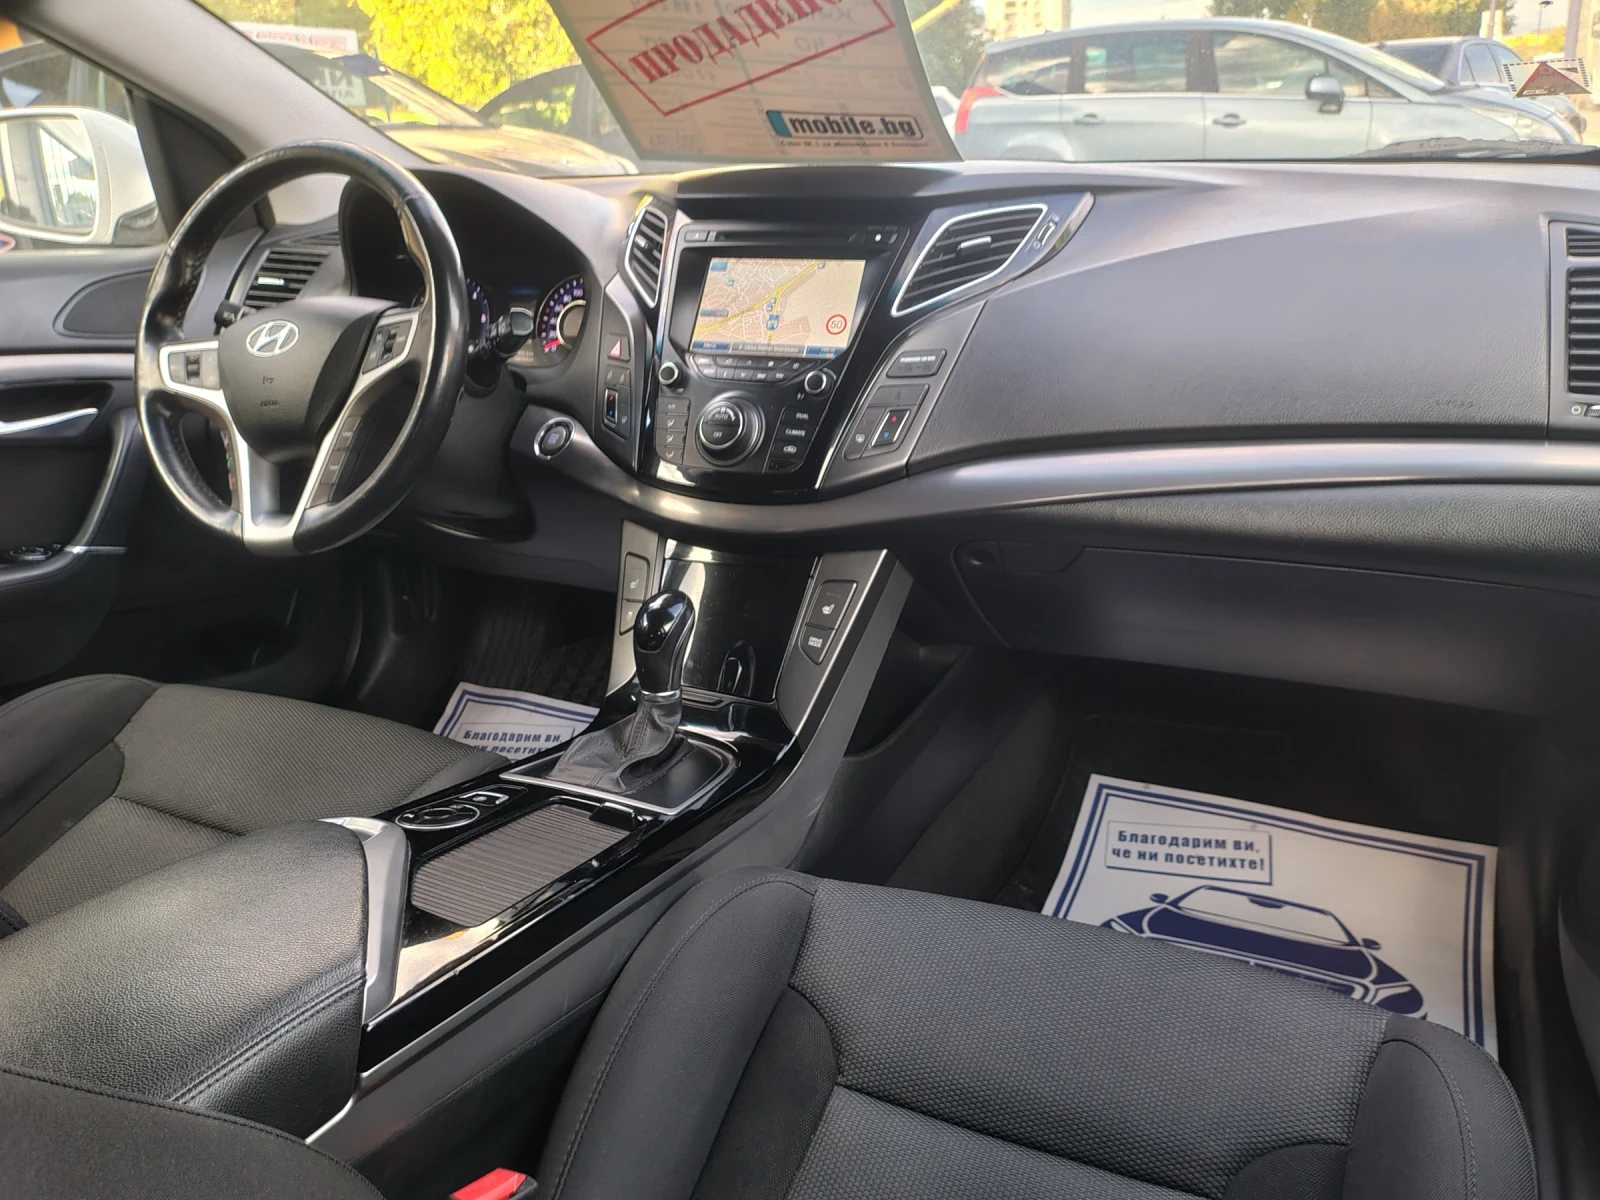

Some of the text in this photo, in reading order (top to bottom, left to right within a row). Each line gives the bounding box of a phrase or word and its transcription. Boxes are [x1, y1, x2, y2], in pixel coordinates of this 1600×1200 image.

[788, 113, 916, 137] mobile.bg
[830, 319, 843, 330] 50
[785, 428, 806, 437] CLIMATE
[463, 730, 541, 744] Благодарим
[1118, 830, 1260, 853] Благодарим ви,
[1112, 848, 1265, 871] че ни посетихте!
